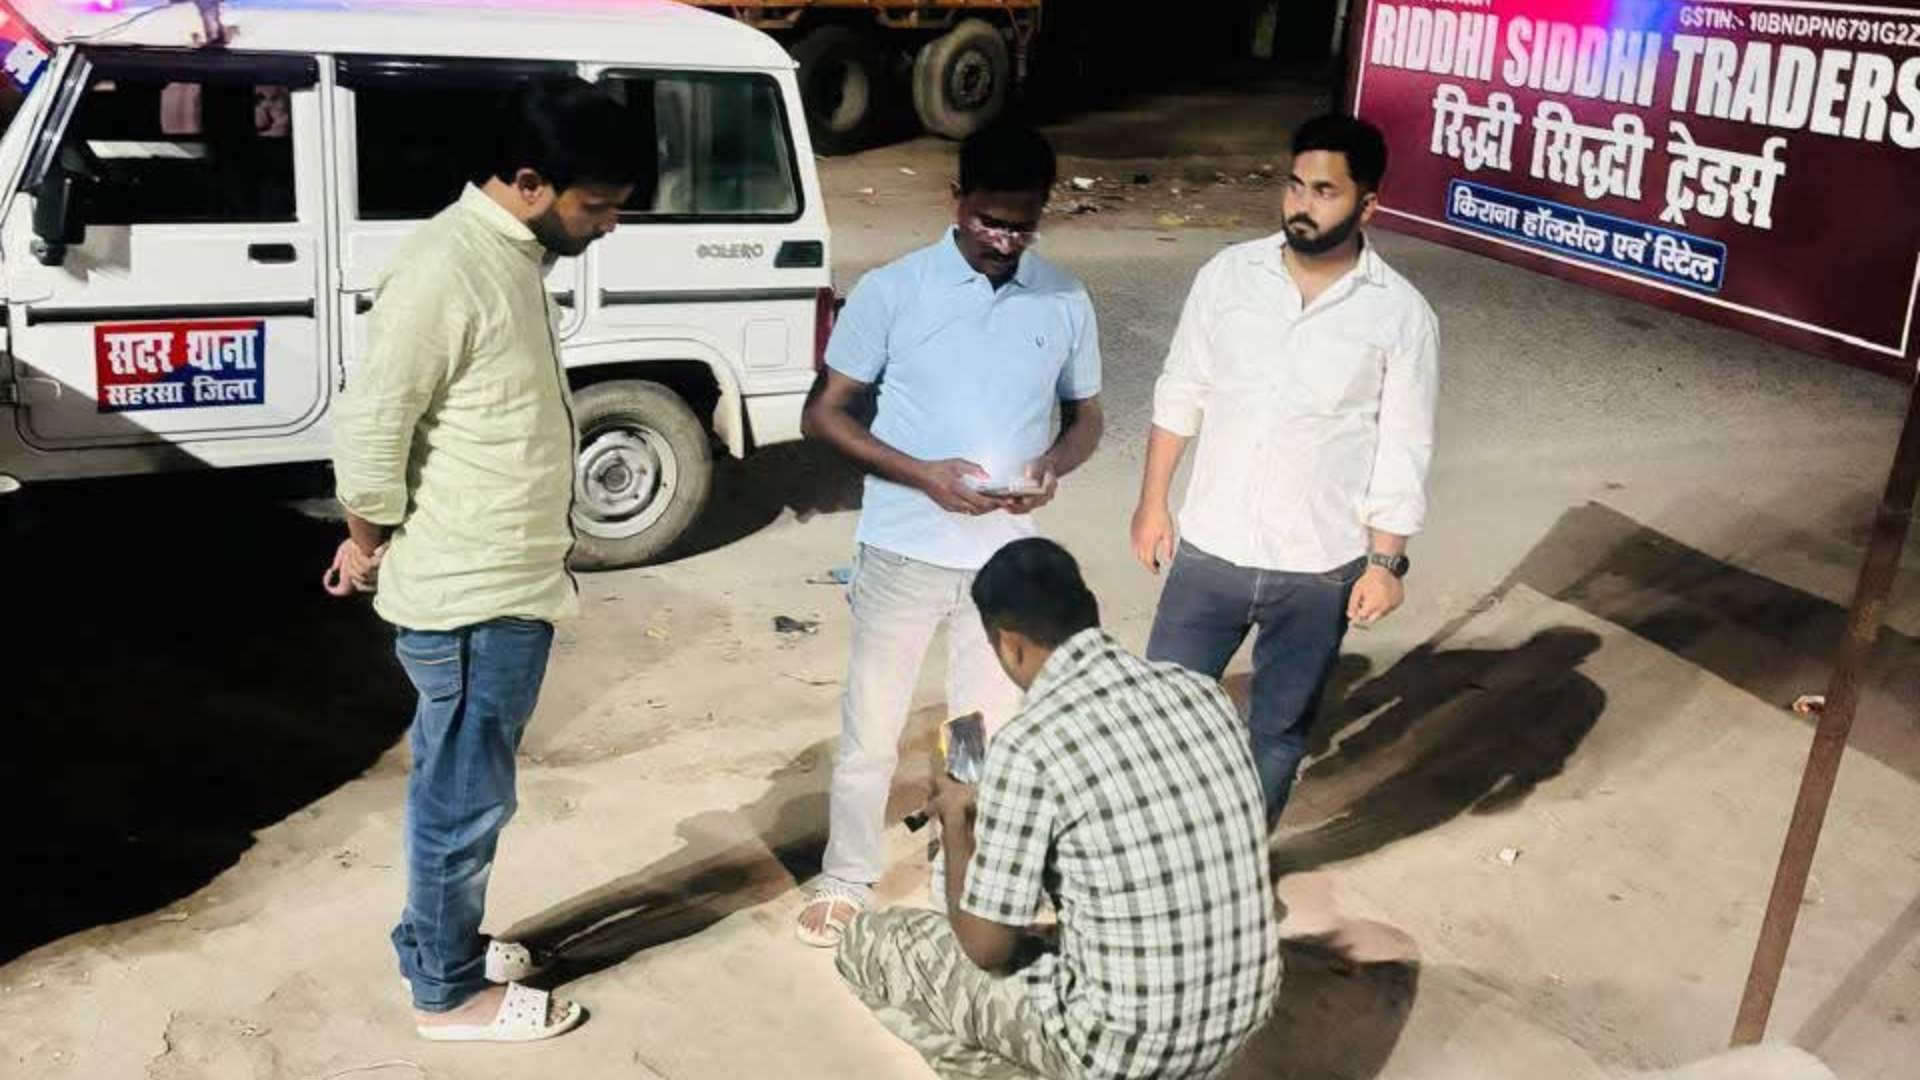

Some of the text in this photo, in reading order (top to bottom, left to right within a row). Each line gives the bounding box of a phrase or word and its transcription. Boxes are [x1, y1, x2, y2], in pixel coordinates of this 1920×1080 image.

[1371, 3, 1920, 149] RIDDHI SIDDHI TRADERS
[1430, 83, 1788, 229] रिद्धी सिद्धी ट्रेडर्स
[1453, 186, 1719, 283] किराना हॉलसेल एवं रिटेल
[104, 332, 174, 375] सदर
[104, 375, 257, 406] सहरसा जिला
